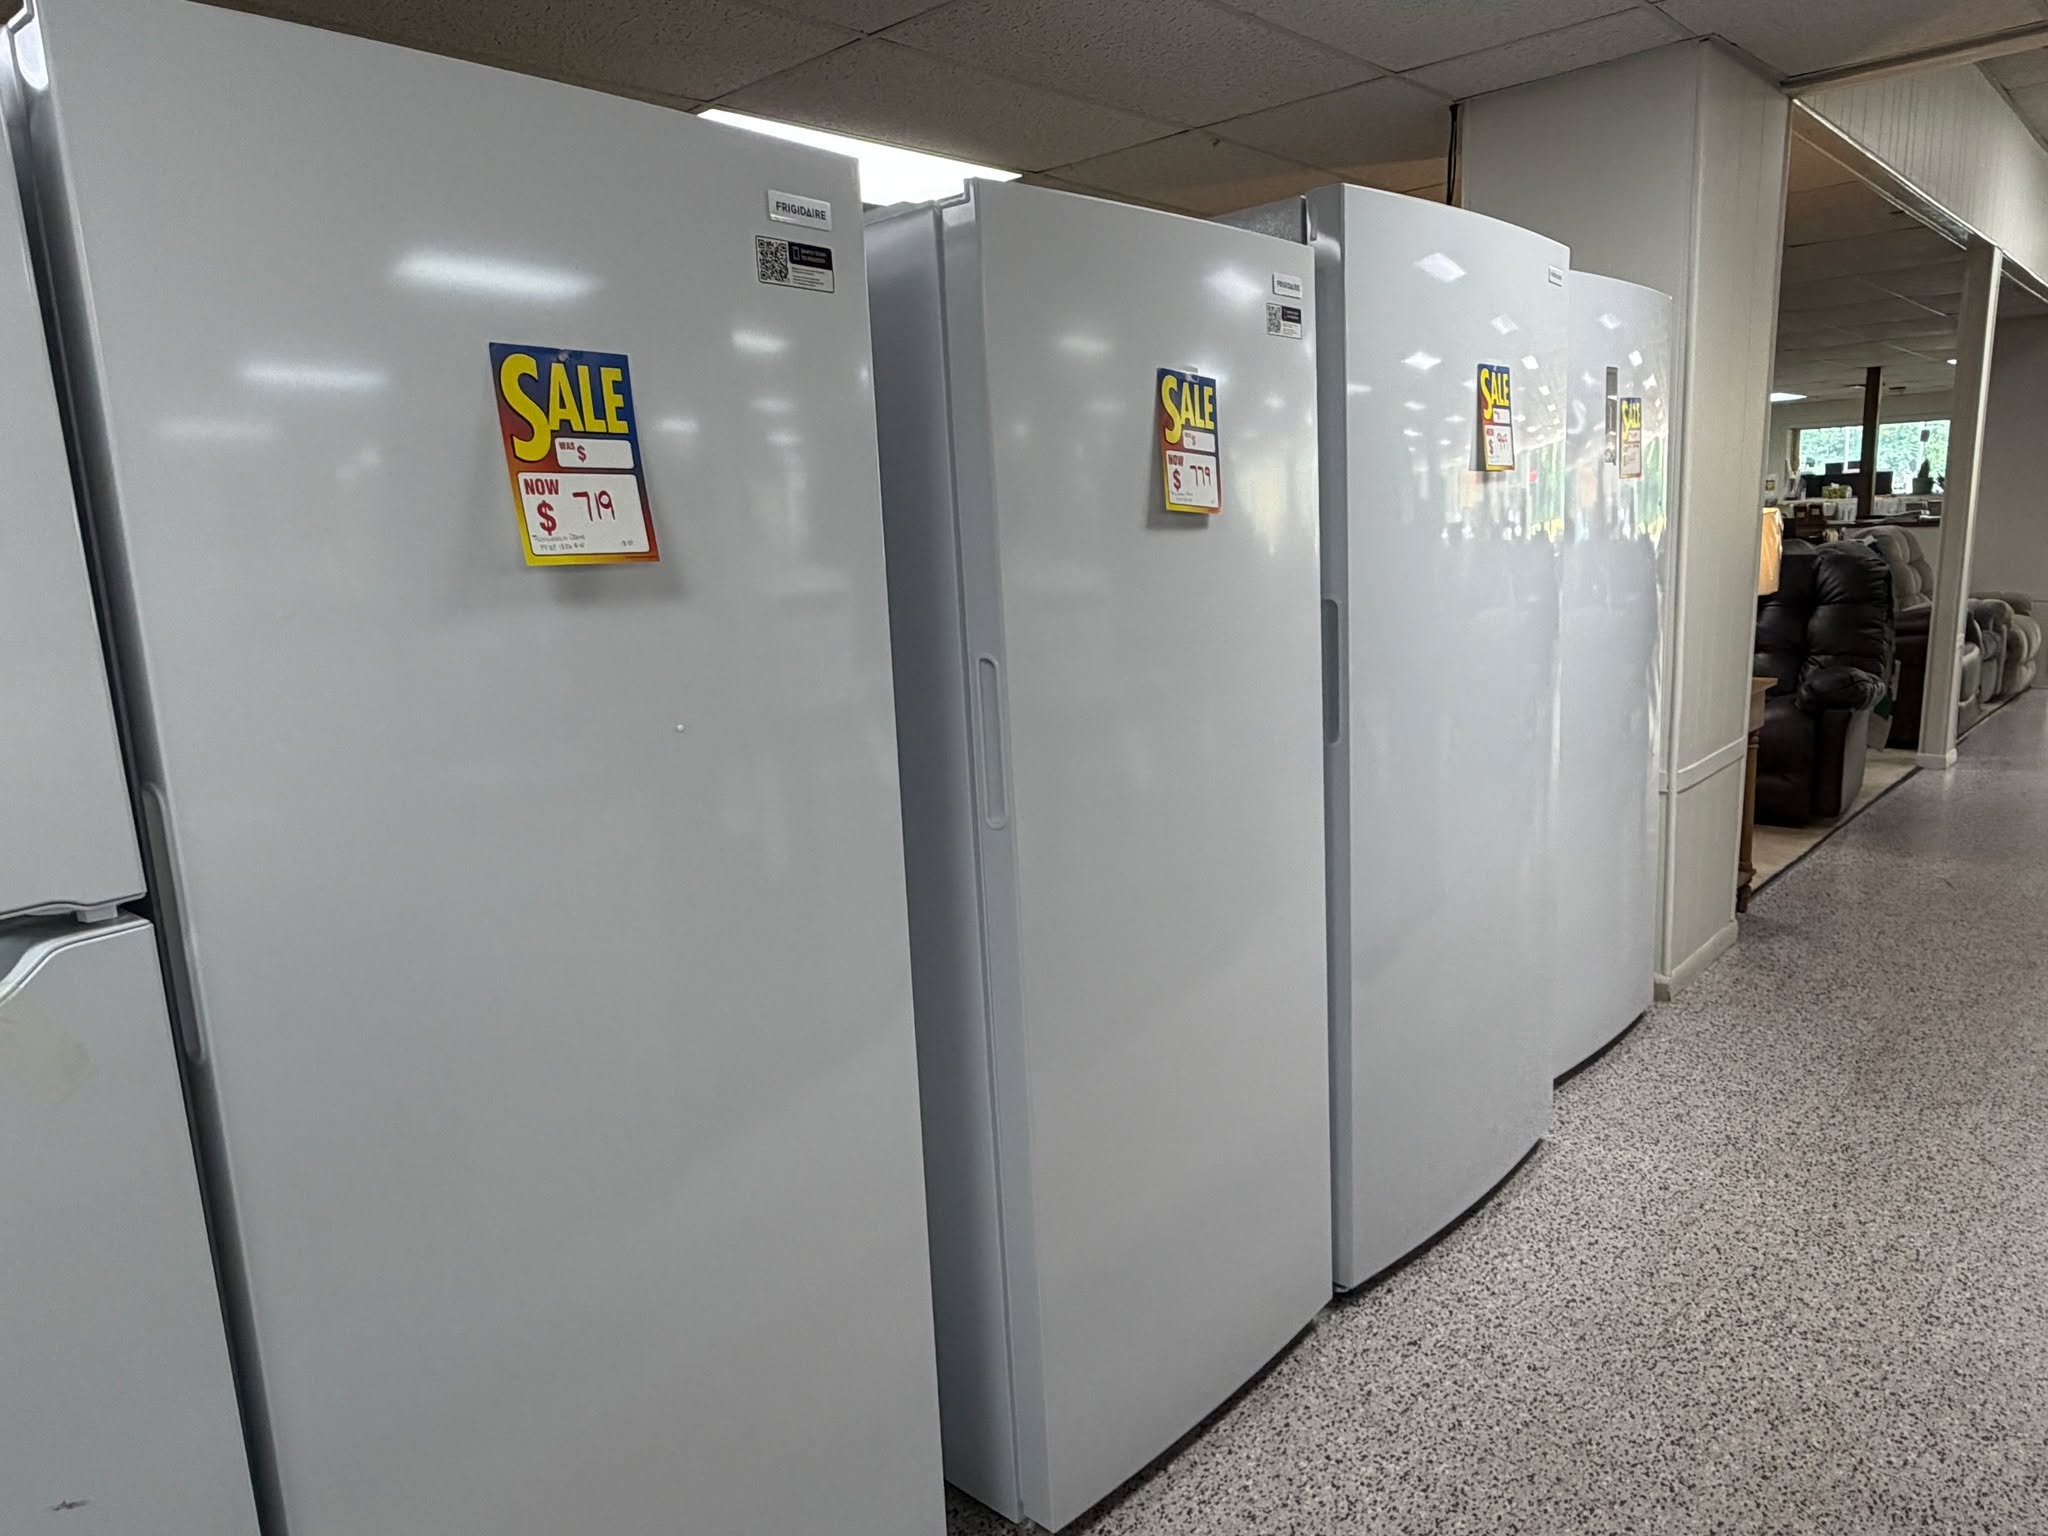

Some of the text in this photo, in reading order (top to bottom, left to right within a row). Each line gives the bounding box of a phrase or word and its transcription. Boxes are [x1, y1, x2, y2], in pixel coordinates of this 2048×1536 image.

[775, 201, 827, 221] FRIGIDAIRE
[500, 353, 630, 462] SALE
[1161, 375, 1215, 444] SALE
[1480, 368, 1510, 420] SALE
[558, 441, 587, 463] WAS $
[523, 479, 560, 496] NOW
[1172, 465, 1212, 492] $ 779
[537, 490, 616, 536] $ 719
